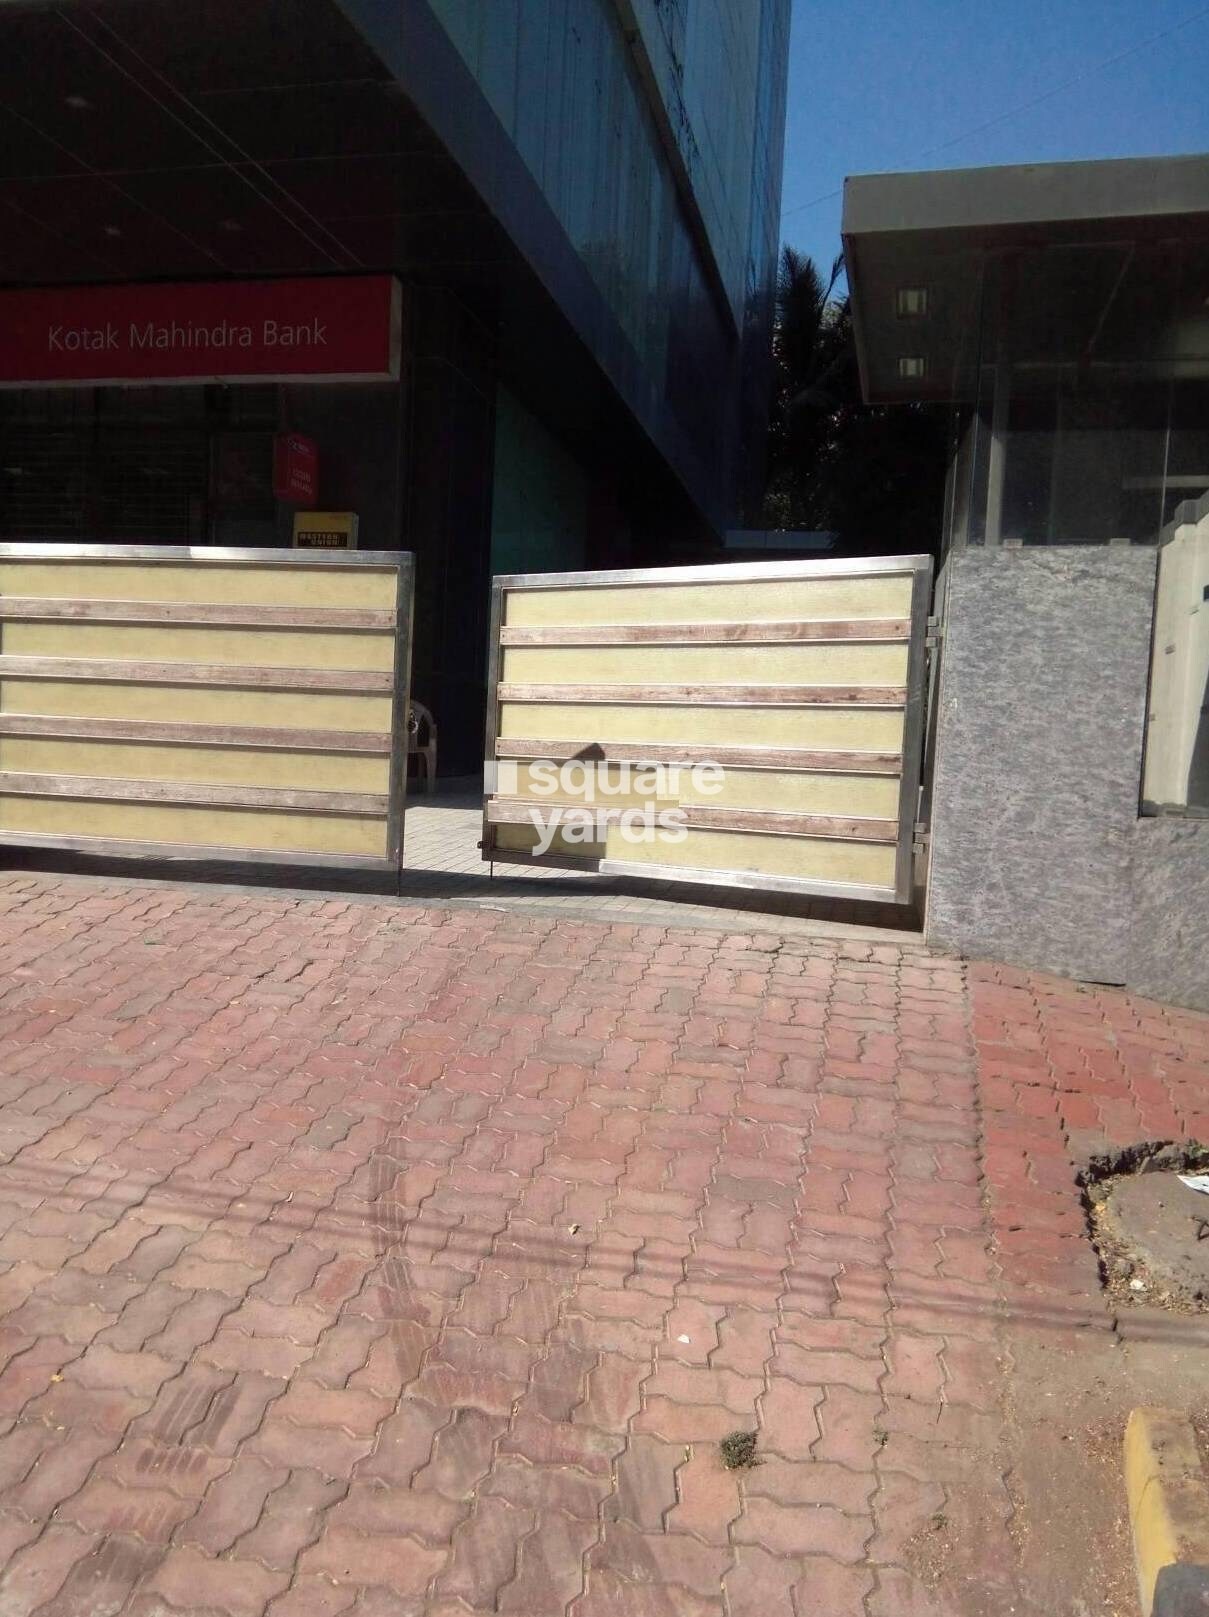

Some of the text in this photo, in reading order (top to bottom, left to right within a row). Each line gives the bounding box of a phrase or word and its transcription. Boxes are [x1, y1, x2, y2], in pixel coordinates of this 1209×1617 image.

[48, 318, 328, 352] Kotak Mahindra Bank
